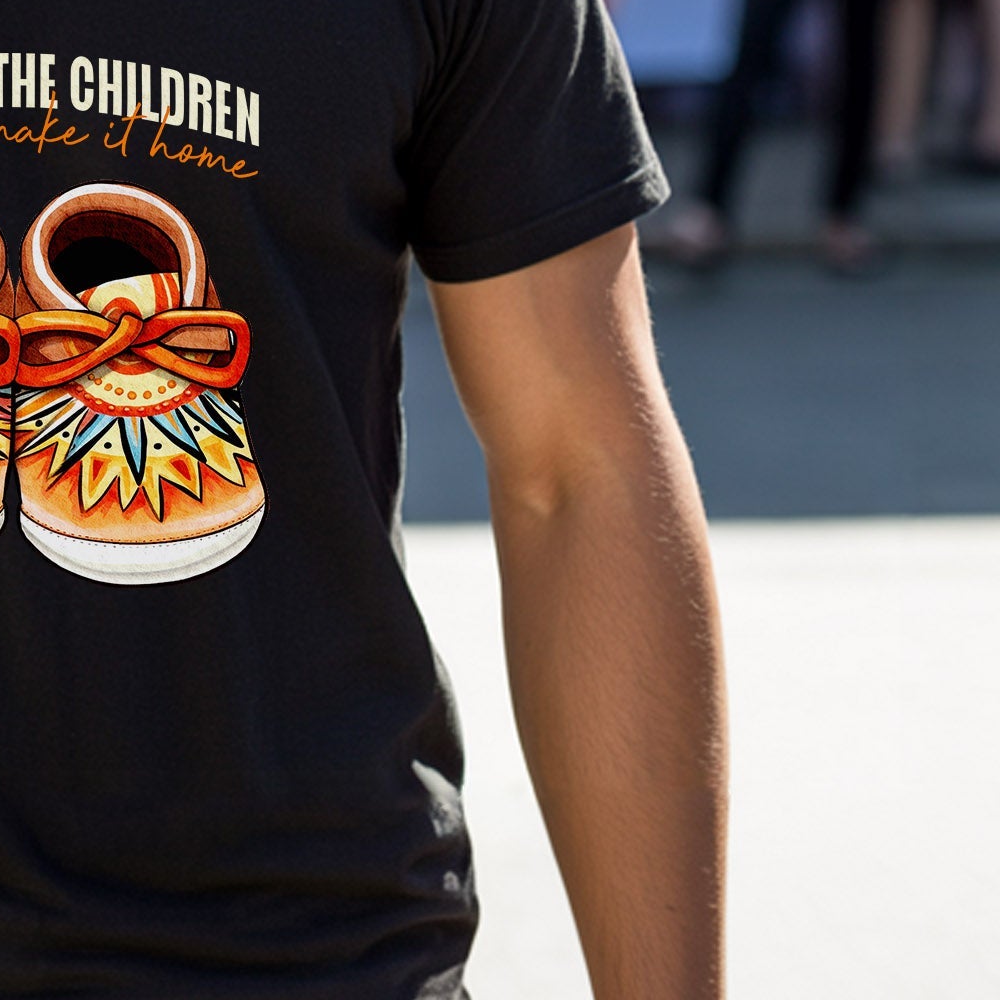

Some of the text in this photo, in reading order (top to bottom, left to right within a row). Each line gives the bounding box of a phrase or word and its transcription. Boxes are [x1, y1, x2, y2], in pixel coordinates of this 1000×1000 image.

[70, 55, 261, 147] CHILDREN
[104, 101, 147, 157] it
[150, 105, 260, 180] home
